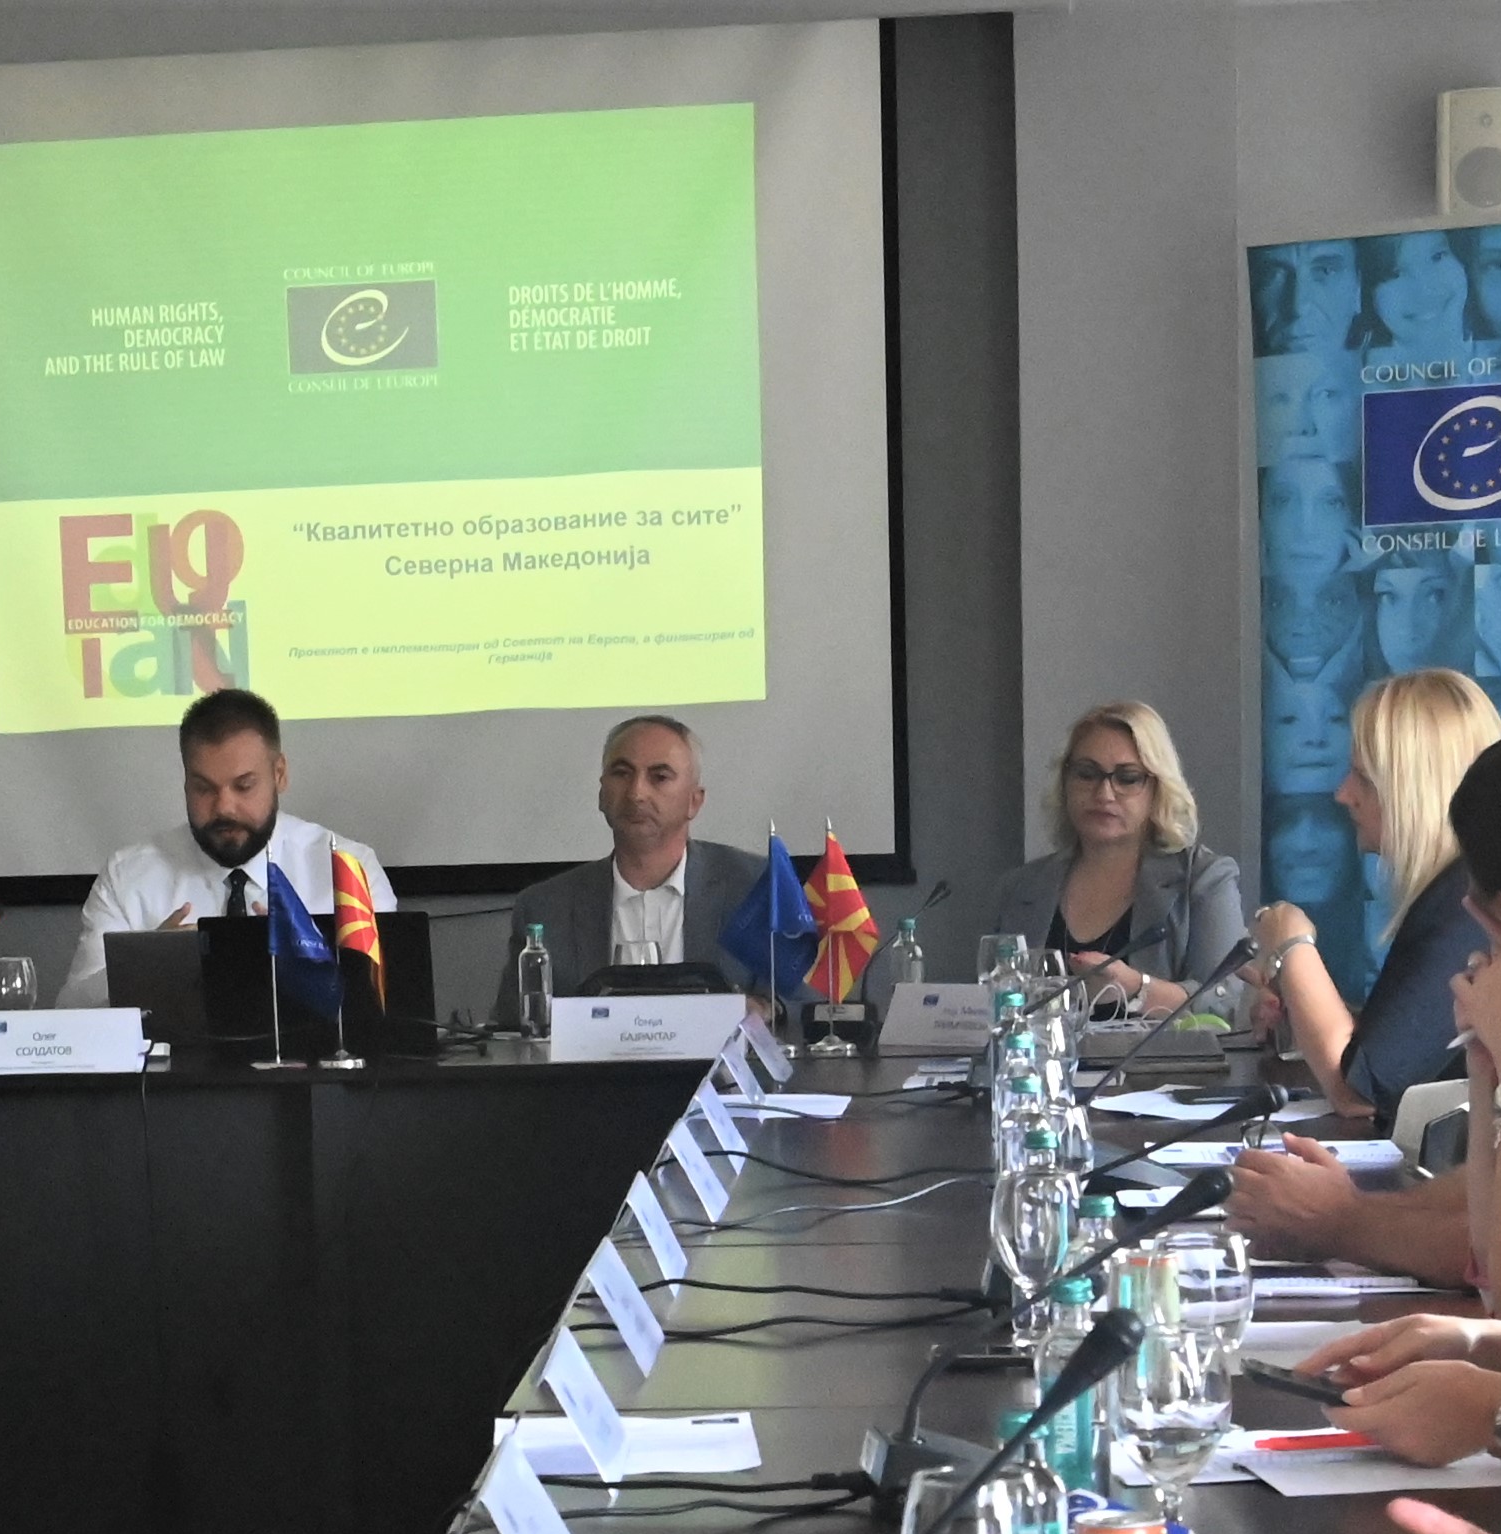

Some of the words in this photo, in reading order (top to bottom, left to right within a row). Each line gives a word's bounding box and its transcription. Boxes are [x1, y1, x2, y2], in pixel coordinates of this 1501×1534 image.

[283, 264, 350, 281] COUNCIL
[356, 263, 376, 279] OF
[381, 261, 435, 277] EUROPE
[509, 283, 569, 304] DROITS
[574, 283, 595, 302] DE
[600, 278, 682, 301] L'HOMME,
[91, 305, 154, 328] HUMAN
[159, 301, 224, 324] RIGHTS,
[509, 305, 616, 328] DÉMOCRATIE
[124, 325, 224, 349] DEMOCRACY
[510, 332, 528, 352] ET
[533, 327, 570, 350] ÉTAT
[576, 330, 597, 349] DE
[602, 326, 651, 348] DROIT
[45, 355, 79, 376] AND
[84, 353, 114, 373] THE
[118, 351, 161, 372] RULE
[164, 350, 184, 369] OF
[189, 348, 225, 367] LAW
[1361, 361, 1461, 384] COUNCIL
[1468, 357, 1497, 375] OF
[288, 377, 349, 394] CONSEIL
[354, 376, 370, 391] DE
[293, 517, 454, 543] “Квалитетно
[462, 508, 629, 540] образование
[636, 508, 663, 527] за
[672, 504, 742, 525] сите”
[1362, 532, 1451, 553] CONSEIL
[1459, 529, 1486, 548] DE
[385, 554, 493, 579] Северна
[502, 546, 651, 573] Македонија
[67, 617, 138, 631] EDUCATION
[140, 614, 165, 628] FOR
[167, 611, 243, 628] DEMOCRACY
[15, 1045, 72, 1057] СОЛДАТОВ
